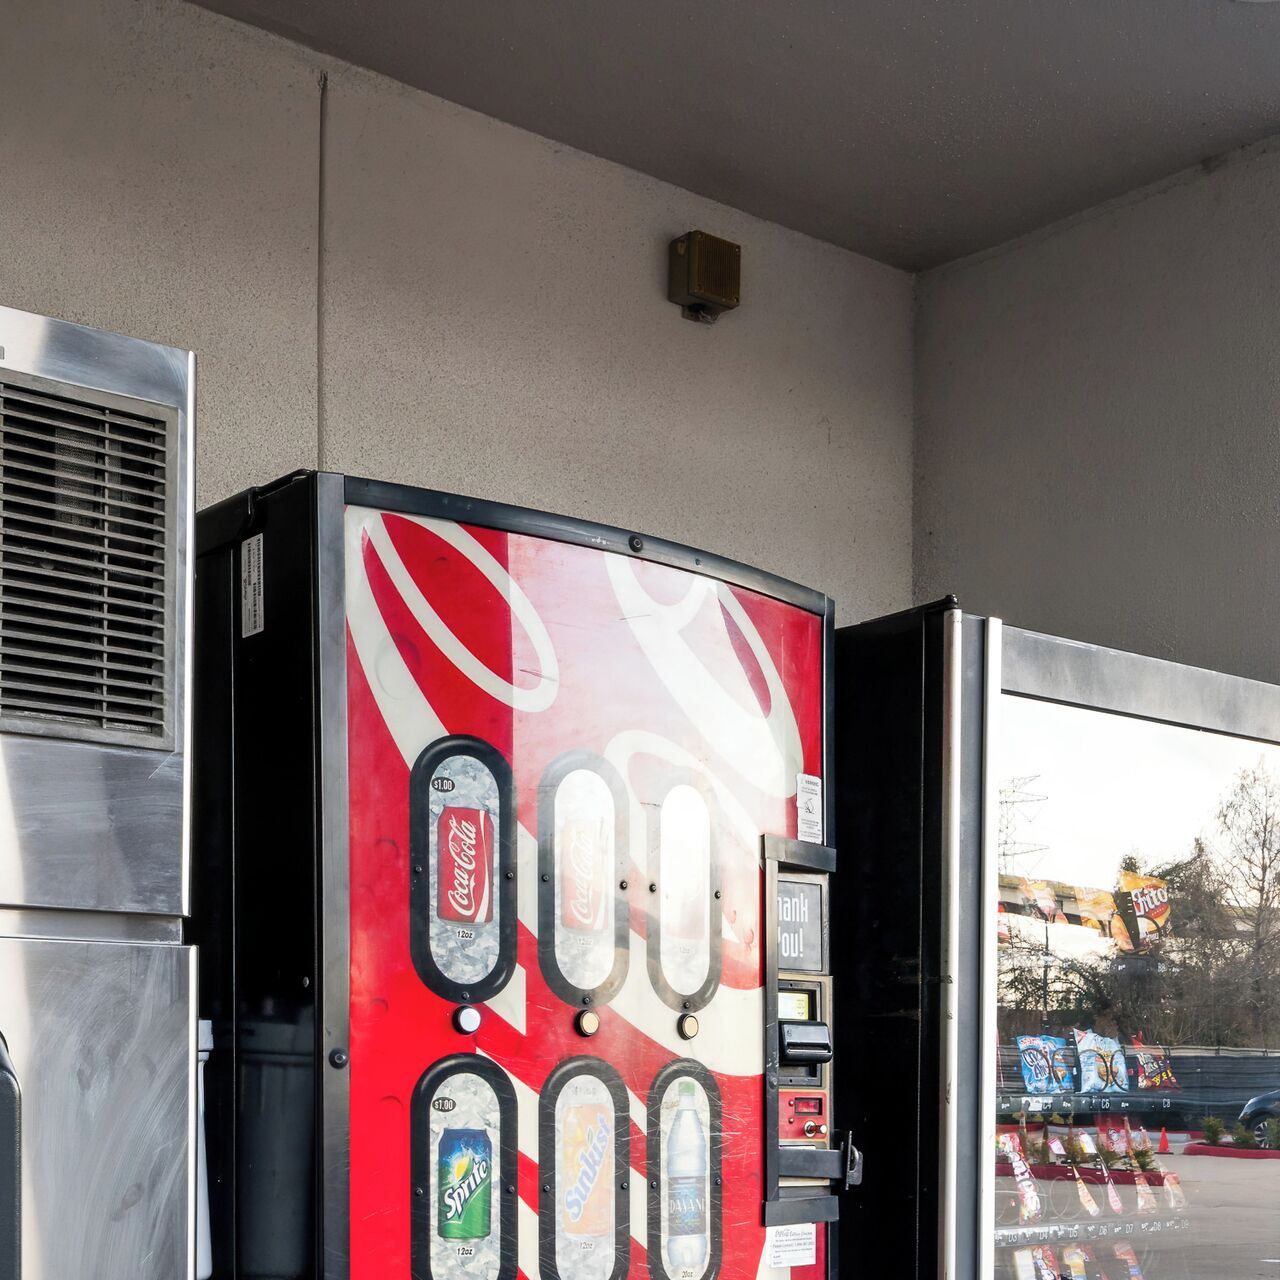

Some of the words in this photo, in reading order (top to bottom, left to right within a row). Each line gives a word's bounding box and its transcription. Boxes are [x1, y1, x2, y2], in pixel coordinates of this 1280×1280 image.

[433, 780, 453, 790] $1.00
[447, 814, 477, 916] Coca-Cola
[457, 930, 473, 939] 12oz
[434, 1099, 454, 1110] $1.00
[565, 1113, 611, 1222] Sunkist
[444, 1160, 488, 1219] Sprite
[457, 1247, 473, 1256] 12oz
